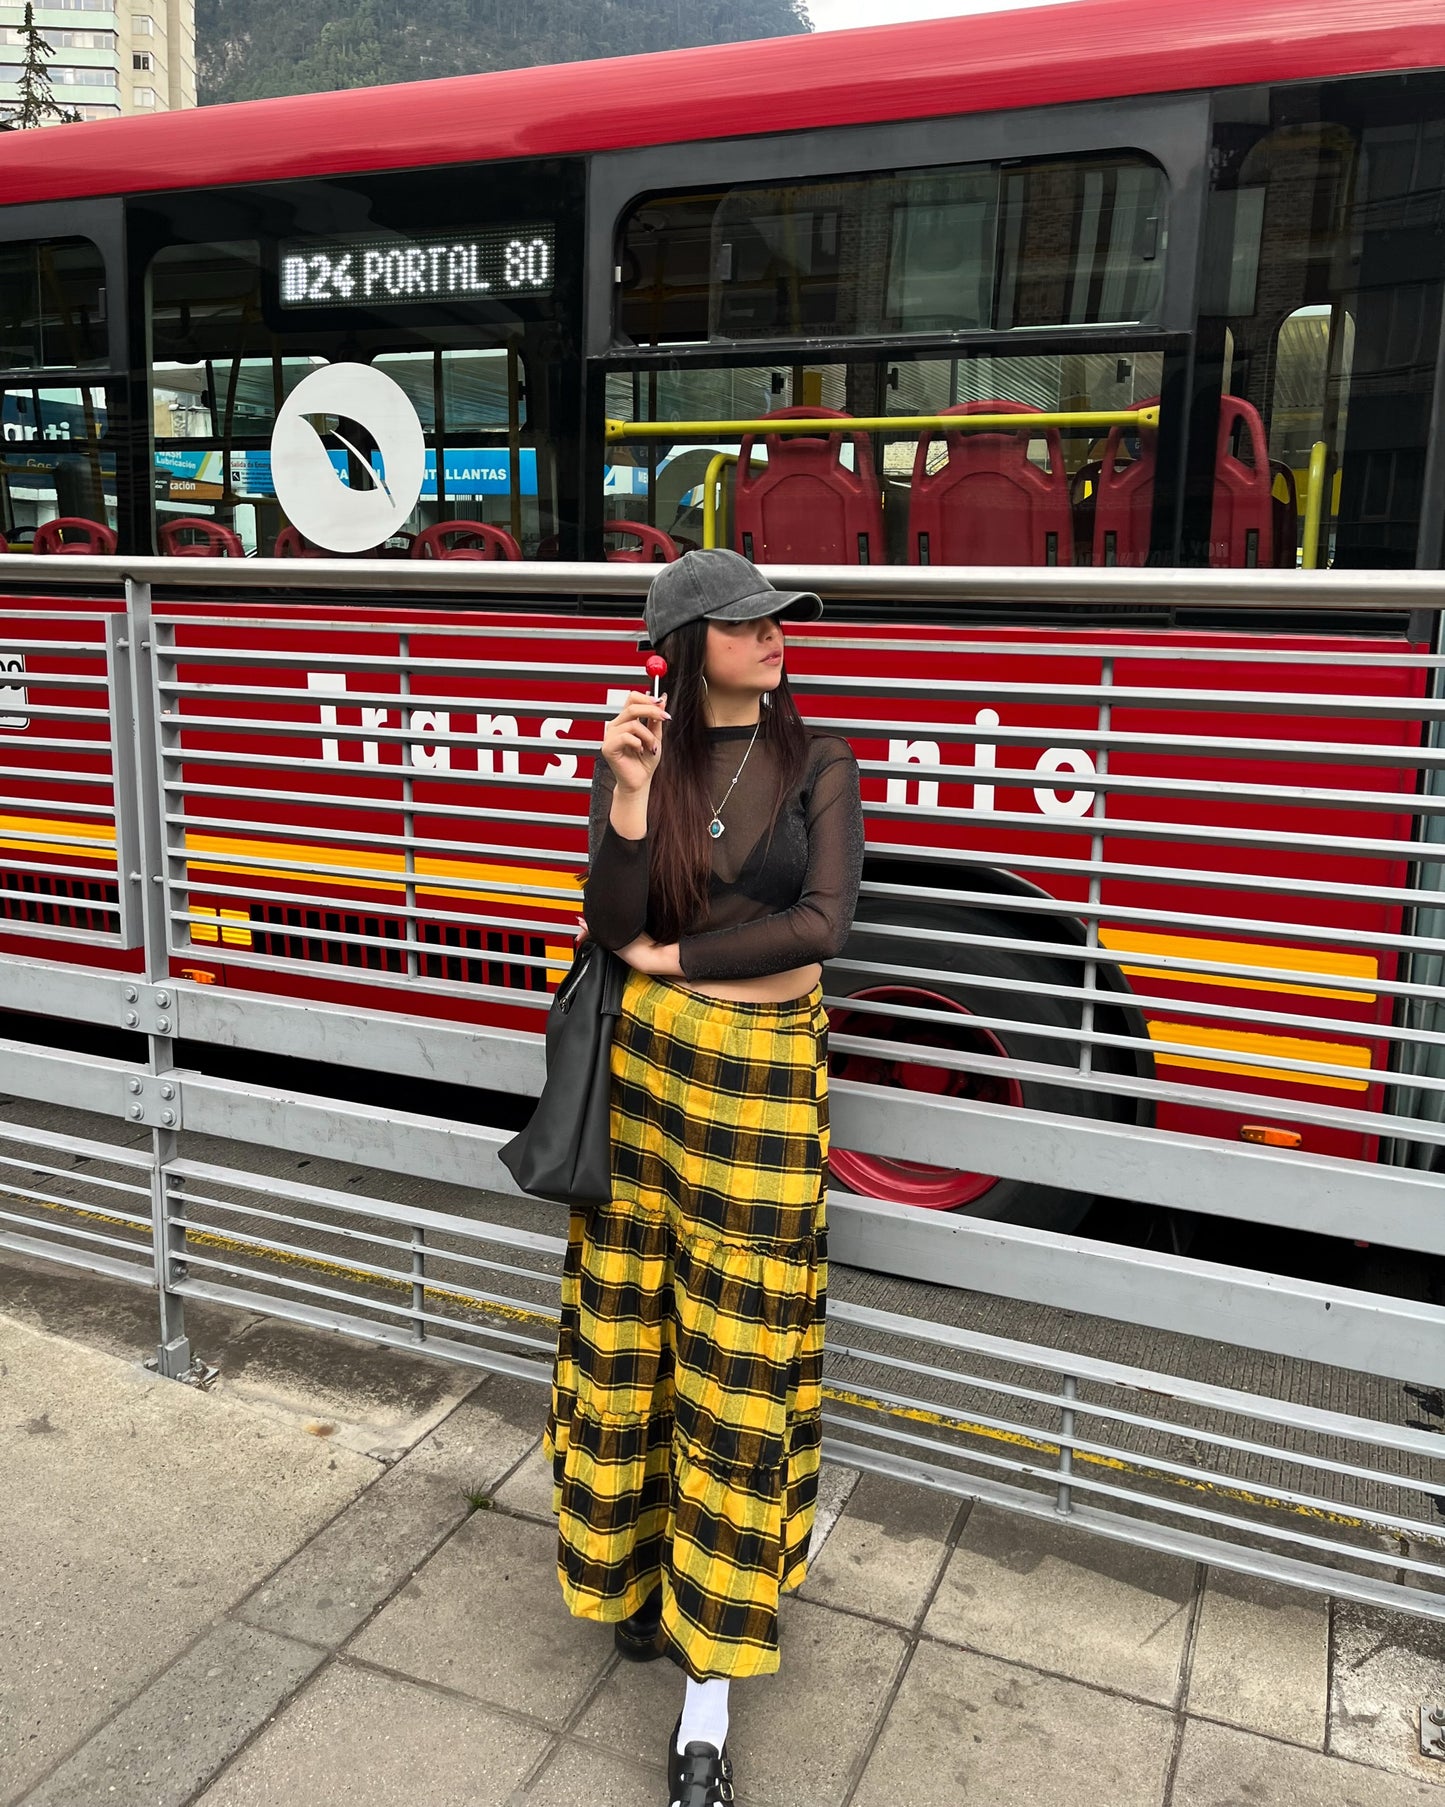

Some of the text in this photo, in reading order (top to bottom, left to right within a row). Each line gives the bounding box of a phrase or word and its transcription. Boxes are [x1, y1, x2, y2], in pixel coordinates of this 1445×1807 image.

[283, 238, 548, 300] D24 PORTAL 80
